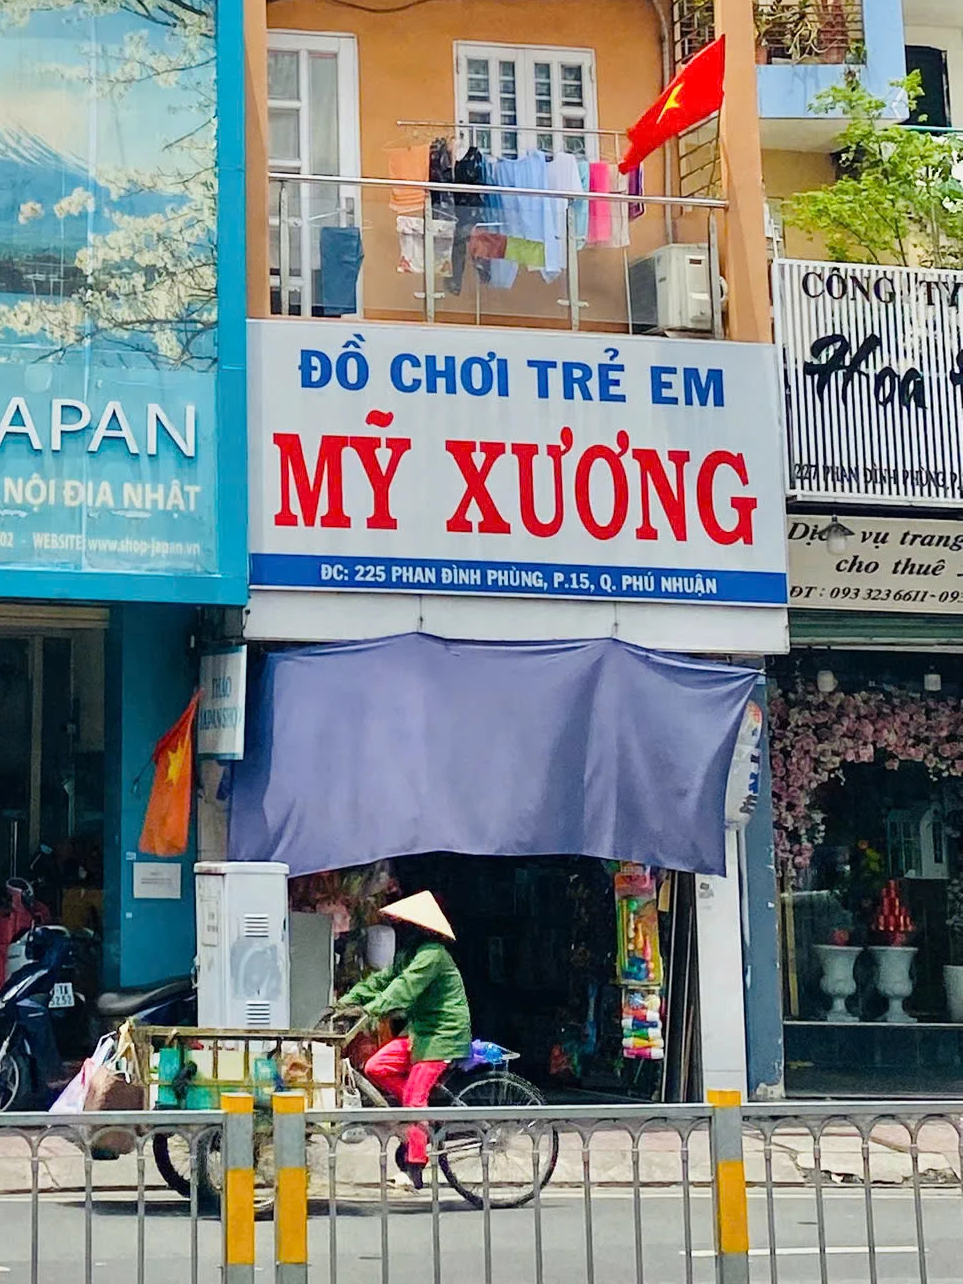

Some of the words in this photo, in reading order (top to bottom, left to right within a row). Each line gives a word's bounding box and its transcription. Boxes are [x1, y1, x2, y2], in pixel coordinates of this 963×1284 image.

[802, 267, 896, 304] CÔNG
[298, 333, 369, 391] ĐỒ
[390, 350, 509, 398] CHƠI
[527, 347, 626, 403] TRẺ
[650, 365, 725, 408] EM
[804, 334, 927, 409] Hoa
[3, 473, 56, 512] NỘI
[123, 479, 202, 518] NHẬT
[272, 409, 412, 530] MỸ
[444, 426, 757, 546] XƯƠNG
[788, 522, 835, 546] Dịc
[861, 531, 890, 549] vụ
[900, 530, 963, 552] trang
[321, 562, 349, 582] ĐC:
[354, 563, 386, 583] 225
[391, 565, 436, 585] PHAN
[441, 563, 482, 586] ĐÌNH
[486, 566, 548, 591] PHÙNG,
[553, 570, 596, 592] P.15,
[599, 573, 617, 593] Q.
[621, 570, 655, 592] PHÚ
[660, 573, 717, 596] NHUẬN
[836, 555, 879, 574] cho
[892, 557, 946, 576] thuê
